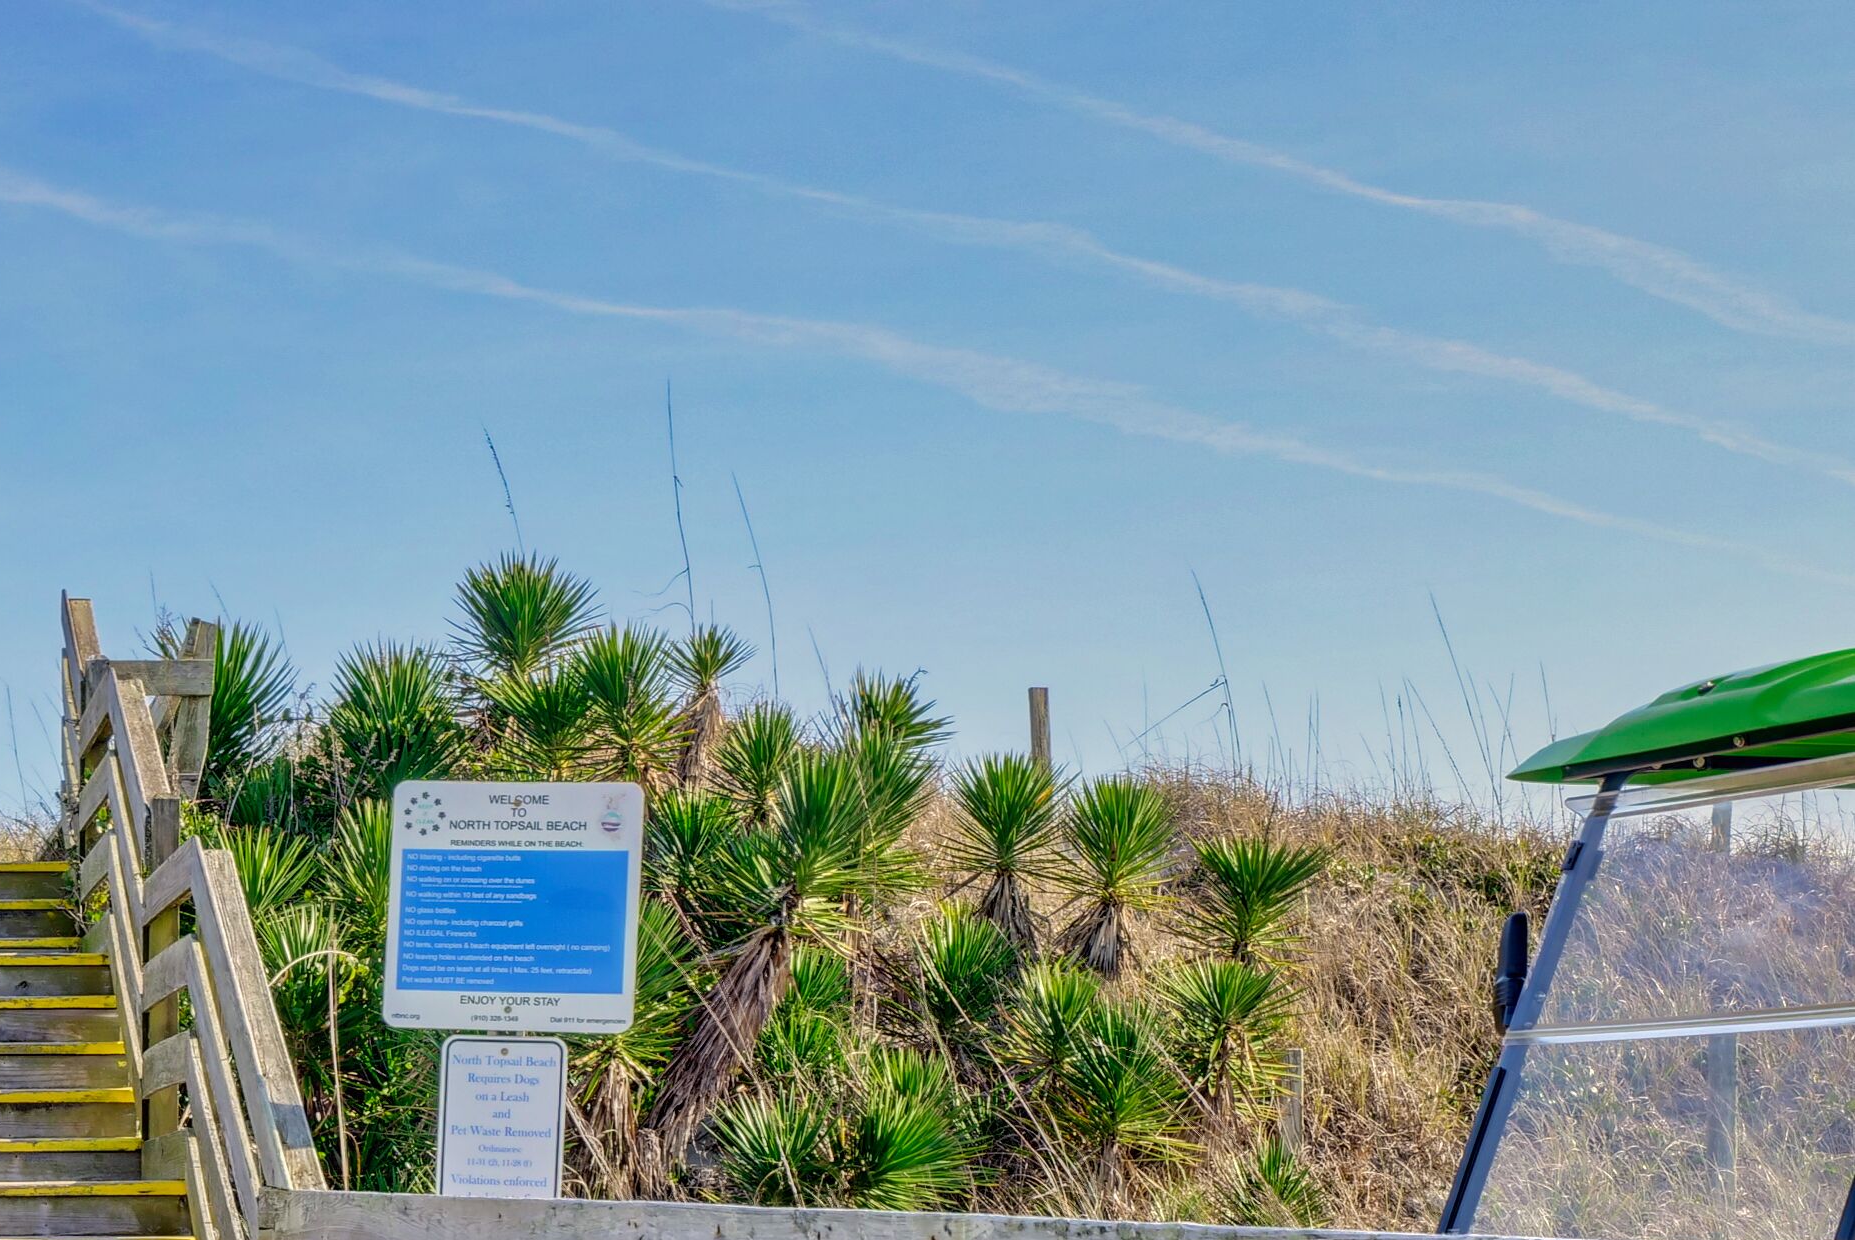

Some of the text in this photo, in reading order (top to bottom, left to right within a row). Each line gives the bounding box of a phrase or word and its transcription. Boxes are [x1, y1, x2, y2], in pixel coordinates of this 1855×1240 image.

[489, 794, 550, 805] WELCOME
[510, 807, 527, 818] TO
[450, 820, 587, 831] NORTH TOPSAIL BEACH
[449, 839, 497, 847] REMINDERS
[497, 840, 523, 848] WHILE
[523, 840, 537, 848] ON
[537, 840, 554, 848] THE
[460, 995, 561, 1007] ENJOY YOUR STAY
[549, 1016, 563, 1024] Dial
[585, 1018, 627, 1026] emergencies
[453, 1055, 556, 1068] North Topsail Beach
[468, 1073, 539, 1085] Requires Dogs
[474, 1091, 529, 1102] on a Leash
[492, 1109, 511, 1119] and
[451, 1125, 551, 1137] Pet Waste Removed
[451, 1174, 546, 1187] Violations enforced
